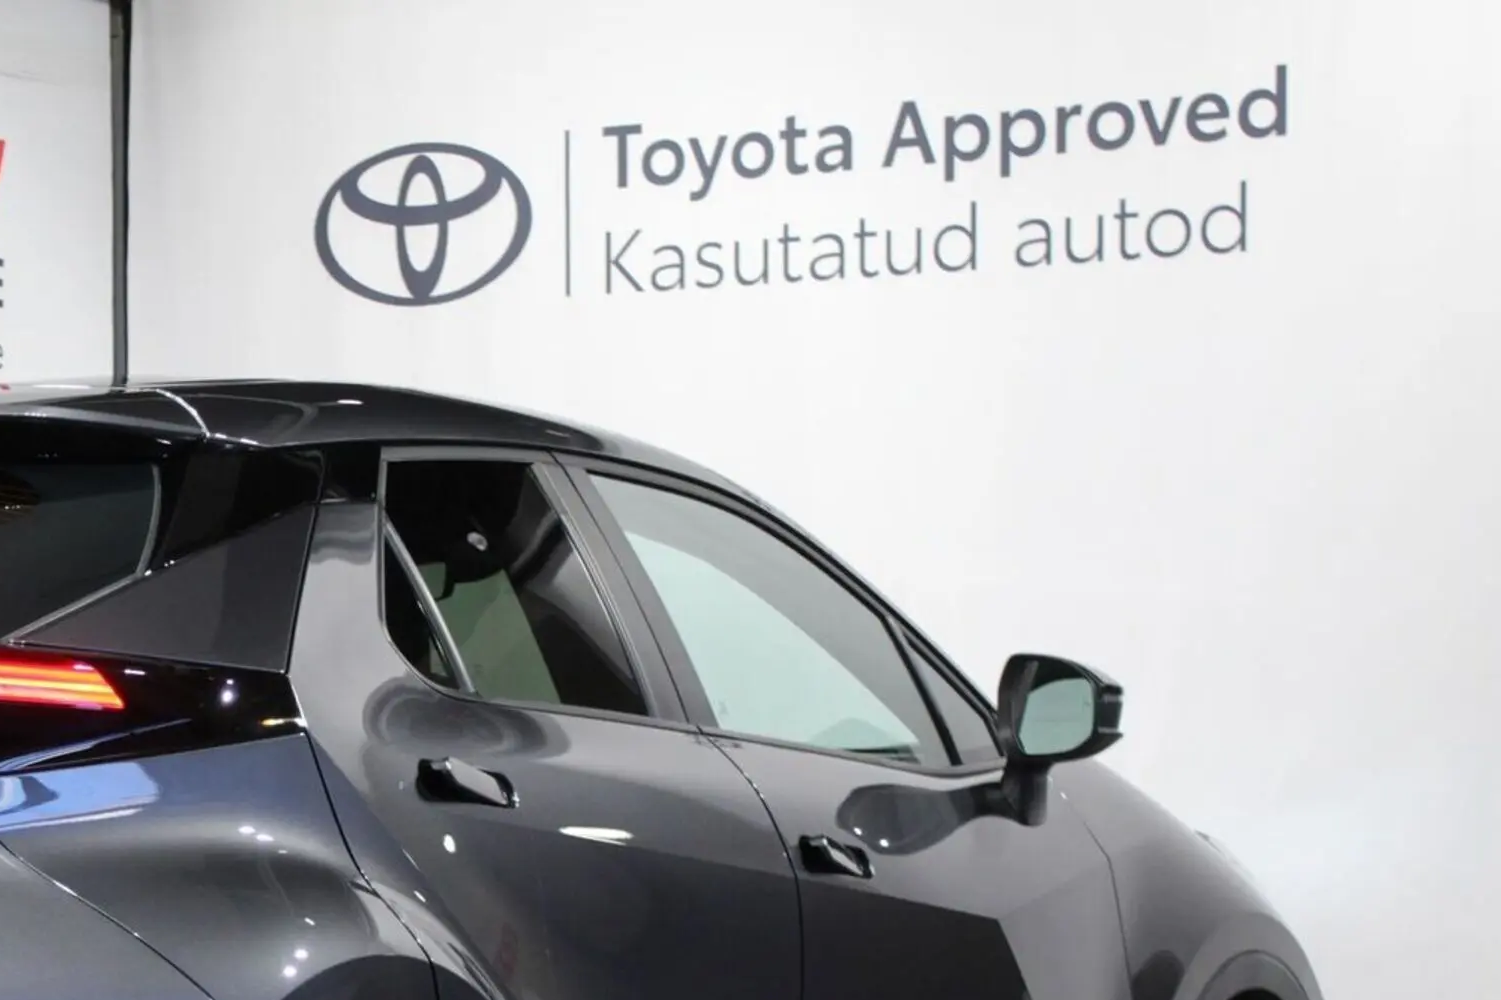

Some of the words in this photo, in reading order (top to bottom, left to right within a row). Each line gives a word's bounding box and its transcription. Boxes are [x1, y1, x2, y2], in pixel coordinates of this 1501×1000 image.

[602, 115, 853, 202] Toyota
[882, 64, 1288, 183] Approved
[605, 200, 978, 295] Kasutatud
[1015, 180, 1247, 268] autod
